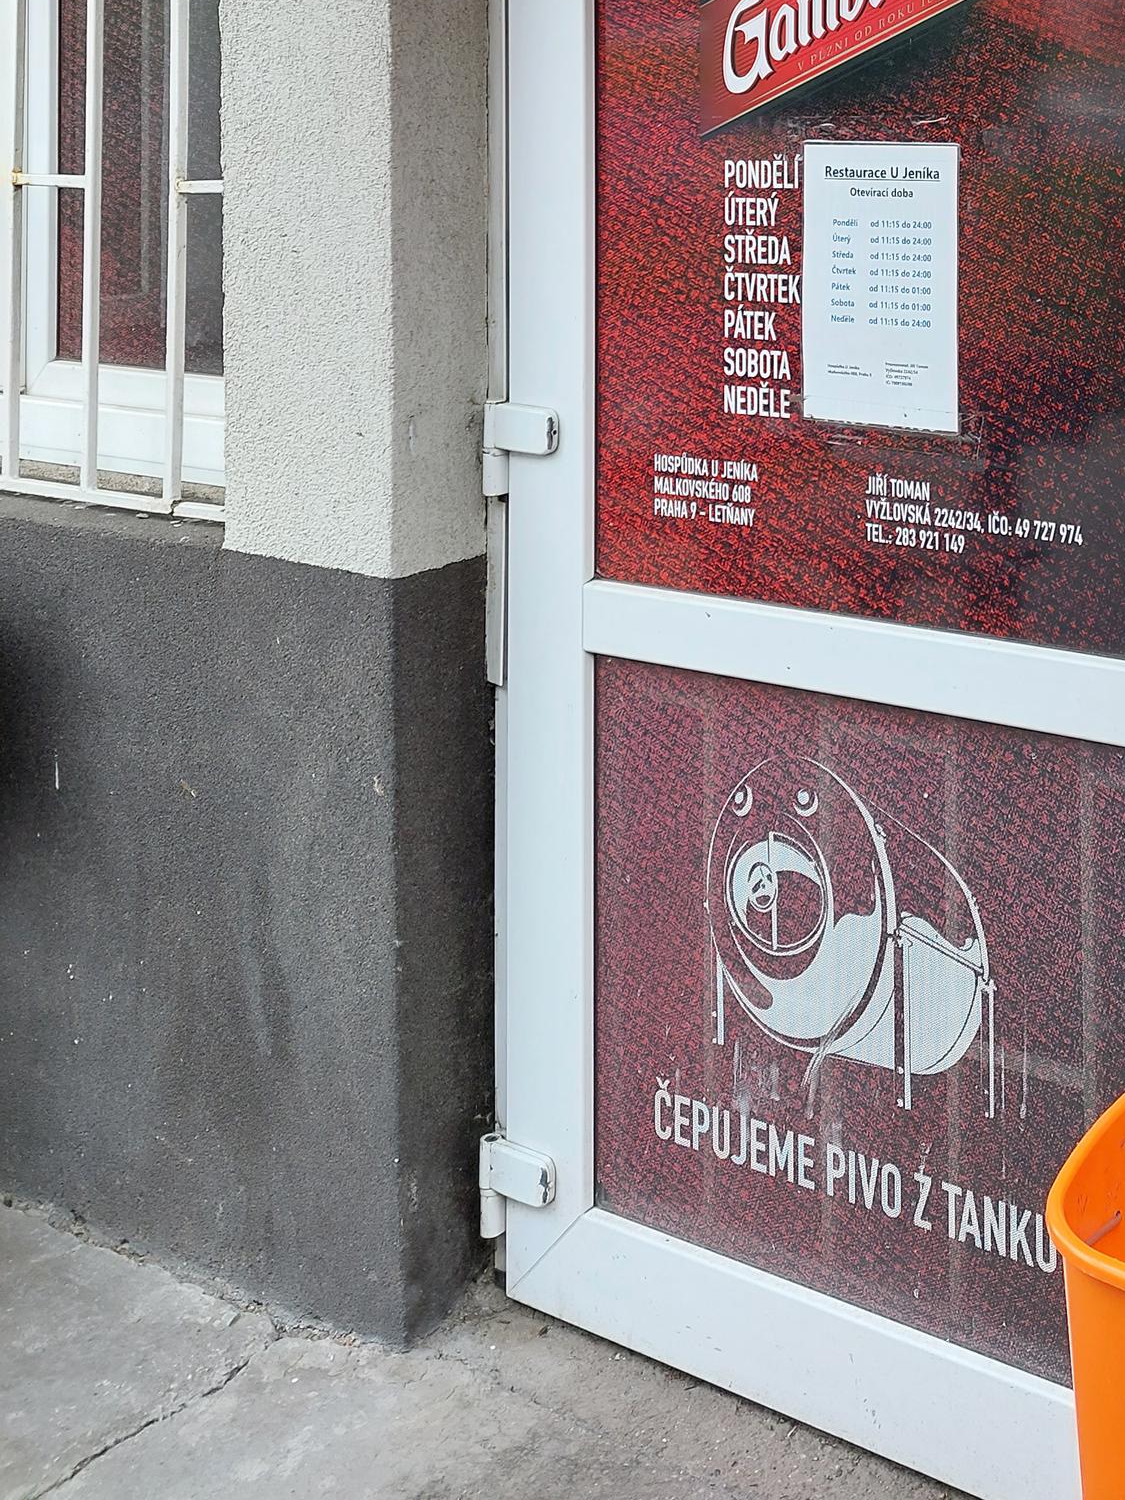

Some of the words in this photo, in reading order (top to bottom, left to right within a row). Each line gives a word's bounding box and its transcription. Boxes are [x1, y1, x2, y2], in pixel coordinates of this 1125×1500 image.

[797, 62, 805, 71] V
[810, 40, 848, 67] PLZNI
[855, 25, 872, 41] OD
[878, 1, 916, 35] ROKU
[724, 154, 803, 190] PONDĚLÍ
[825, 165, 887, 179] Restaurace
[891, 166, 899, 179] U
[903, 166, 940, 180] Jeníka
[891, 187, 914, 198] doba
[724, 191, 780, 227] ÚTERÝ
[870, 220, 879, 228] od
[881, 220, 900, 229] 11:15
[902, 221, 911, 229] do
[912, 221, 932, 230] 24:00
[724, 229, 792, 266] STŘEDA
[870, 236, 879, 244] od
[881, 236, 900, 245] 11:15
[902, 237, 911, 245] do
[912, 237, 932, 246] 24:00
[881, 253, 900, 261] 11:15
[912, 254, 932, 262] 24:00
[724, 265, 802, 304] ČTVRTEK
[870, 269, 879, 277] od
[881, 269, 900, 278] 11:15
[902, 270, 911, 278] do
[912, 270, 932, 279] 24:00
[869, 285, 878, 293] od
[880, 285, 899, 294] 11:15
[901, 286, 910, 294] do
[911, 286, 931, 295] 01:00
[869, 301, 878, 309] od
[880, 301, 899, 310] 11:15
[901, 302, 910, 310] do
[911, 302, 931, 311] 01:00
[724, 303, 777, 341] PÁTEK
[869, 318, 878, 326] od
[880, 318, 899, 327] 11:15
[901, 319, 910, 327] do
[911, 319, 931, 328] 24:00
[723, 347, 792, 381] SOBOTA
[724, 380, 791, 419] NEDĚLE
[654, 452, 709, 477] HOSPŮDKA
[711, 460, 718, 477] U
[721, 459, 758, 482] JENÍKA
[654, 475, 729, 501] MALKOVSKÉHO
[732, 484, 751, 504] 608
[866, 472, 888, 497] JIŘÍ
[890, 478, 931, 501] TOMAN
[654, 498, 688, 519] PRAHA
[690, 502, 697, 520] 9
[708, 502, 755, 527] LETŇANY
[866, 497, 931, 526] VYŽLOVSKÁ
[988, 511, 1012, 537] IČO:
[1015, 518, 1030, 539] 49
[1034, 520, 1057, 542] 727
[1060, 523, 1084, 546] 974
[866, 522, 893, 545] TEL.:
[895, 526, 916, 547] 283
[919, 530, 940, 551] 921
[944, 533, 965, 554] 149
[654, 1075, 816, 1191] ČEPUJEME
[827, 1142, 903, 1219] PIVO
[942, 1181, 1058, 1274] TANKU
